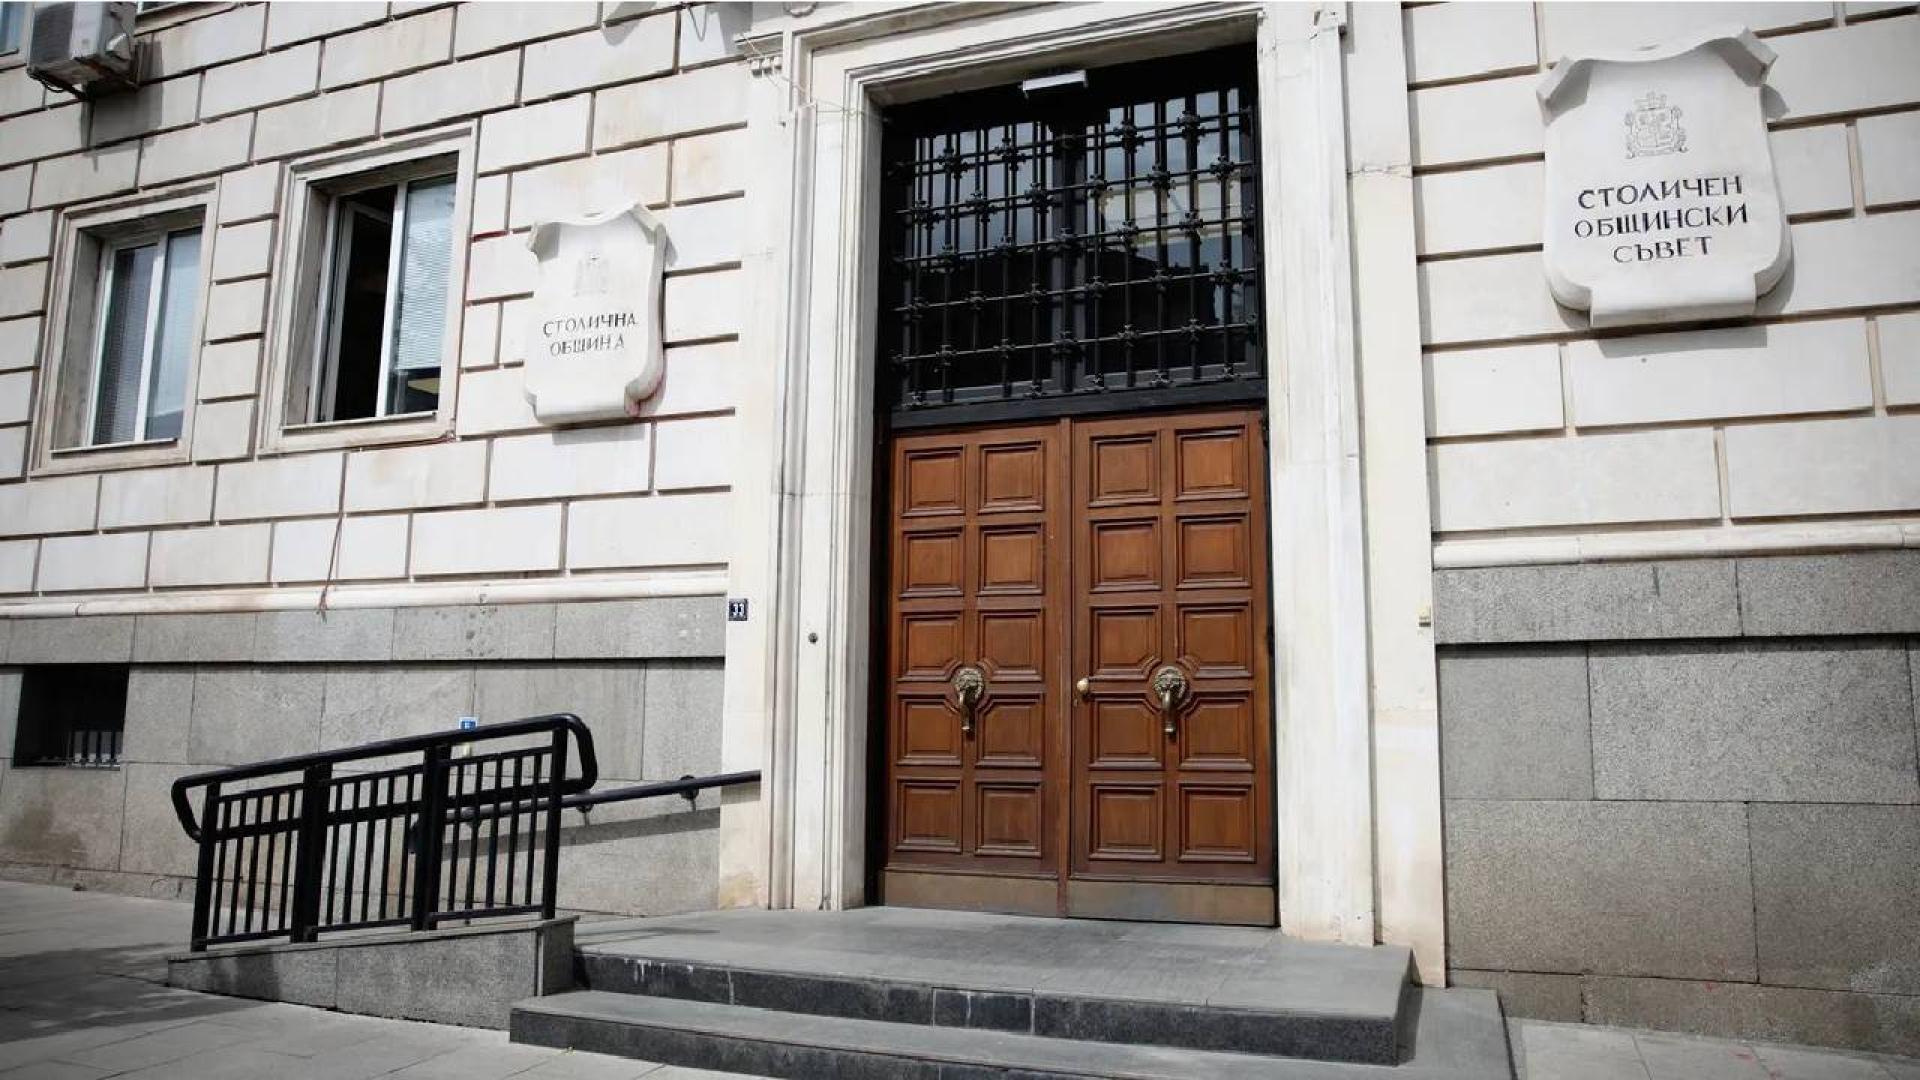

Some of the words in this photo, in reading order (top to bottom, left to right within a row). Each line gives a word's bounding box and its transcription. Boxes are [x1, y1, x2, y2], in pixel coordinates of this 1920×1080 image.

[1578, 175, 1743, 209] СТОЛИЧЕН
[1574, 203, 1748, 238] ОБЩИНСКИ
[1613, 236, 1712, 263] СЪВЕТ
[542, 312, 637, 337] СТОЛИЧНА
[550, 334, 625, 357] ОБЩИНА
